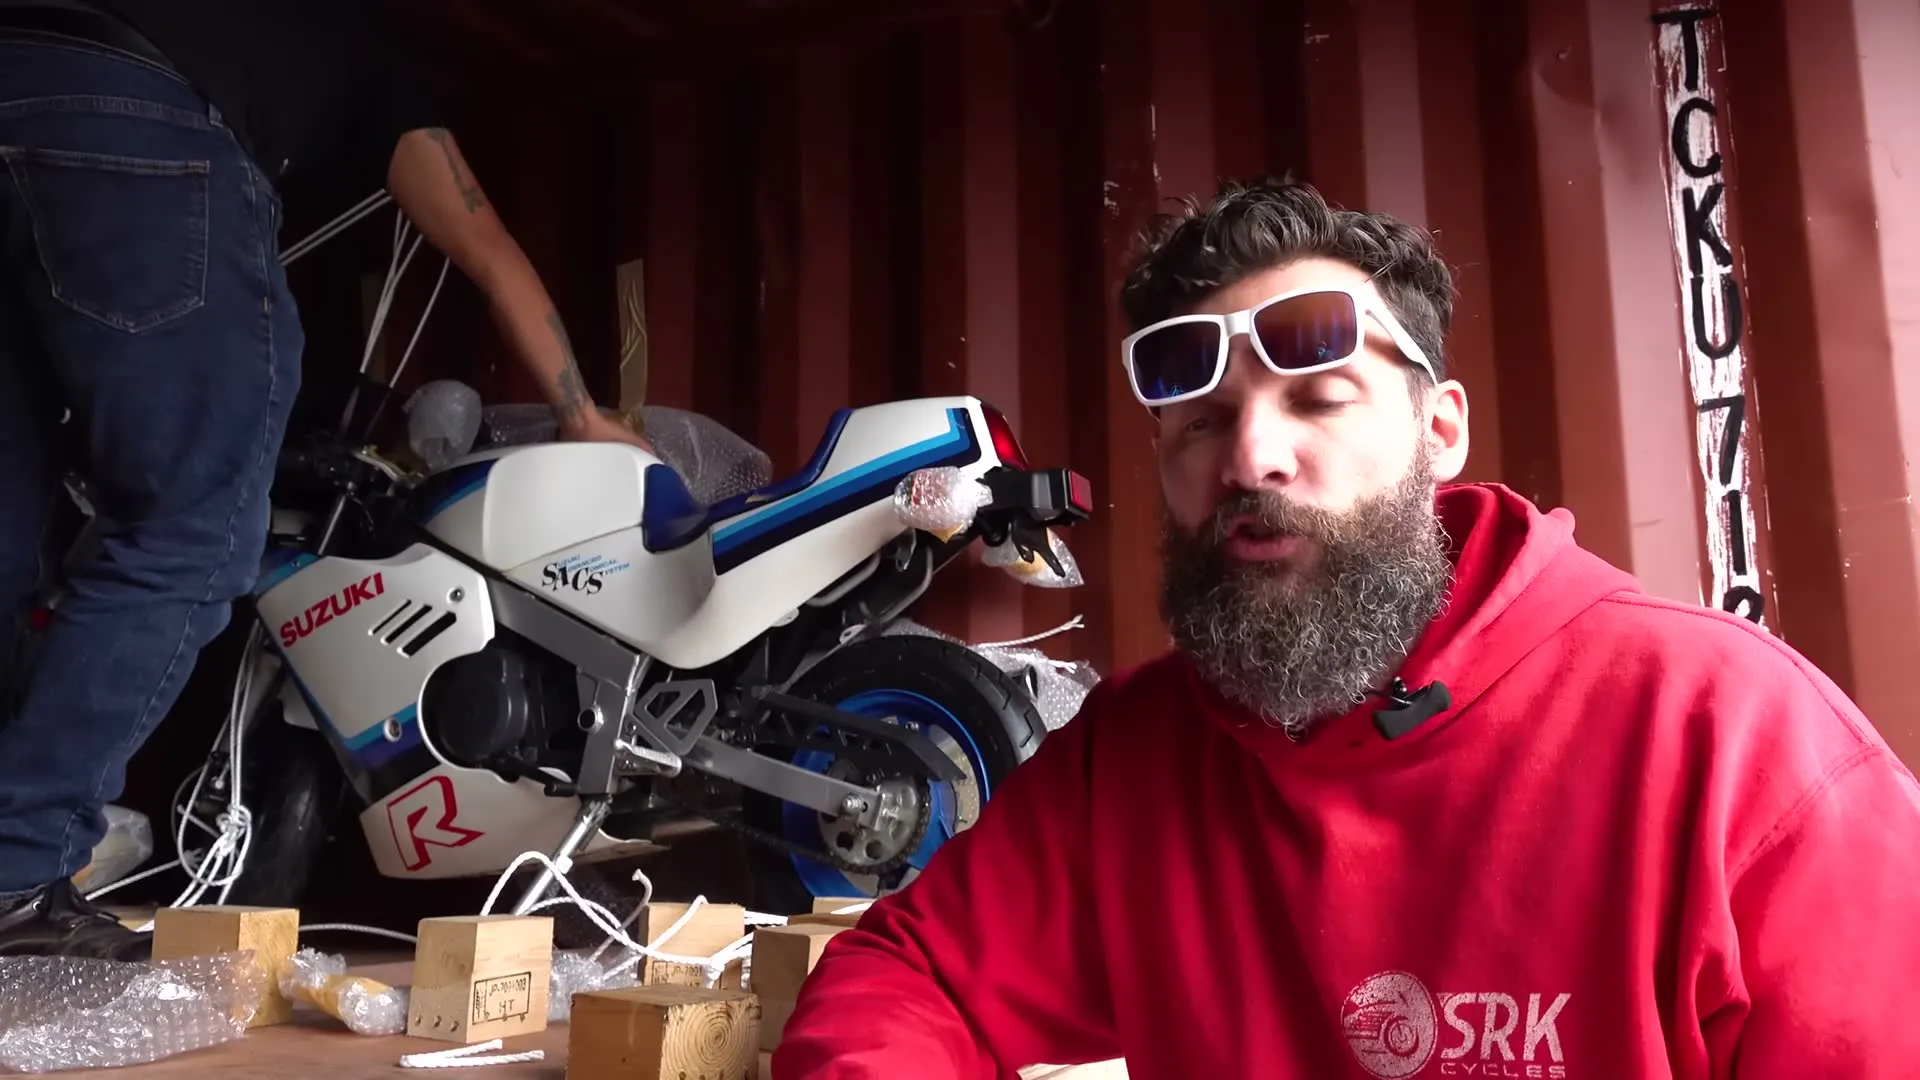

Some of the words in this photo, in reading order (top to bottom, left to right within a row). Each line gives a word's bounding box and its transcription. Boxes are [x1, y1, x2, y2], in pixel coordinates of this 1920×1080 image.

[279, 571, 385, 648] SUZUKI
[541, 562, 604, 596] SACS
[386, 775, 485, 872] R
[1436, 992, 1572, 1062] SRK
[1440, 1062, 1566, 1079] CYCLES
